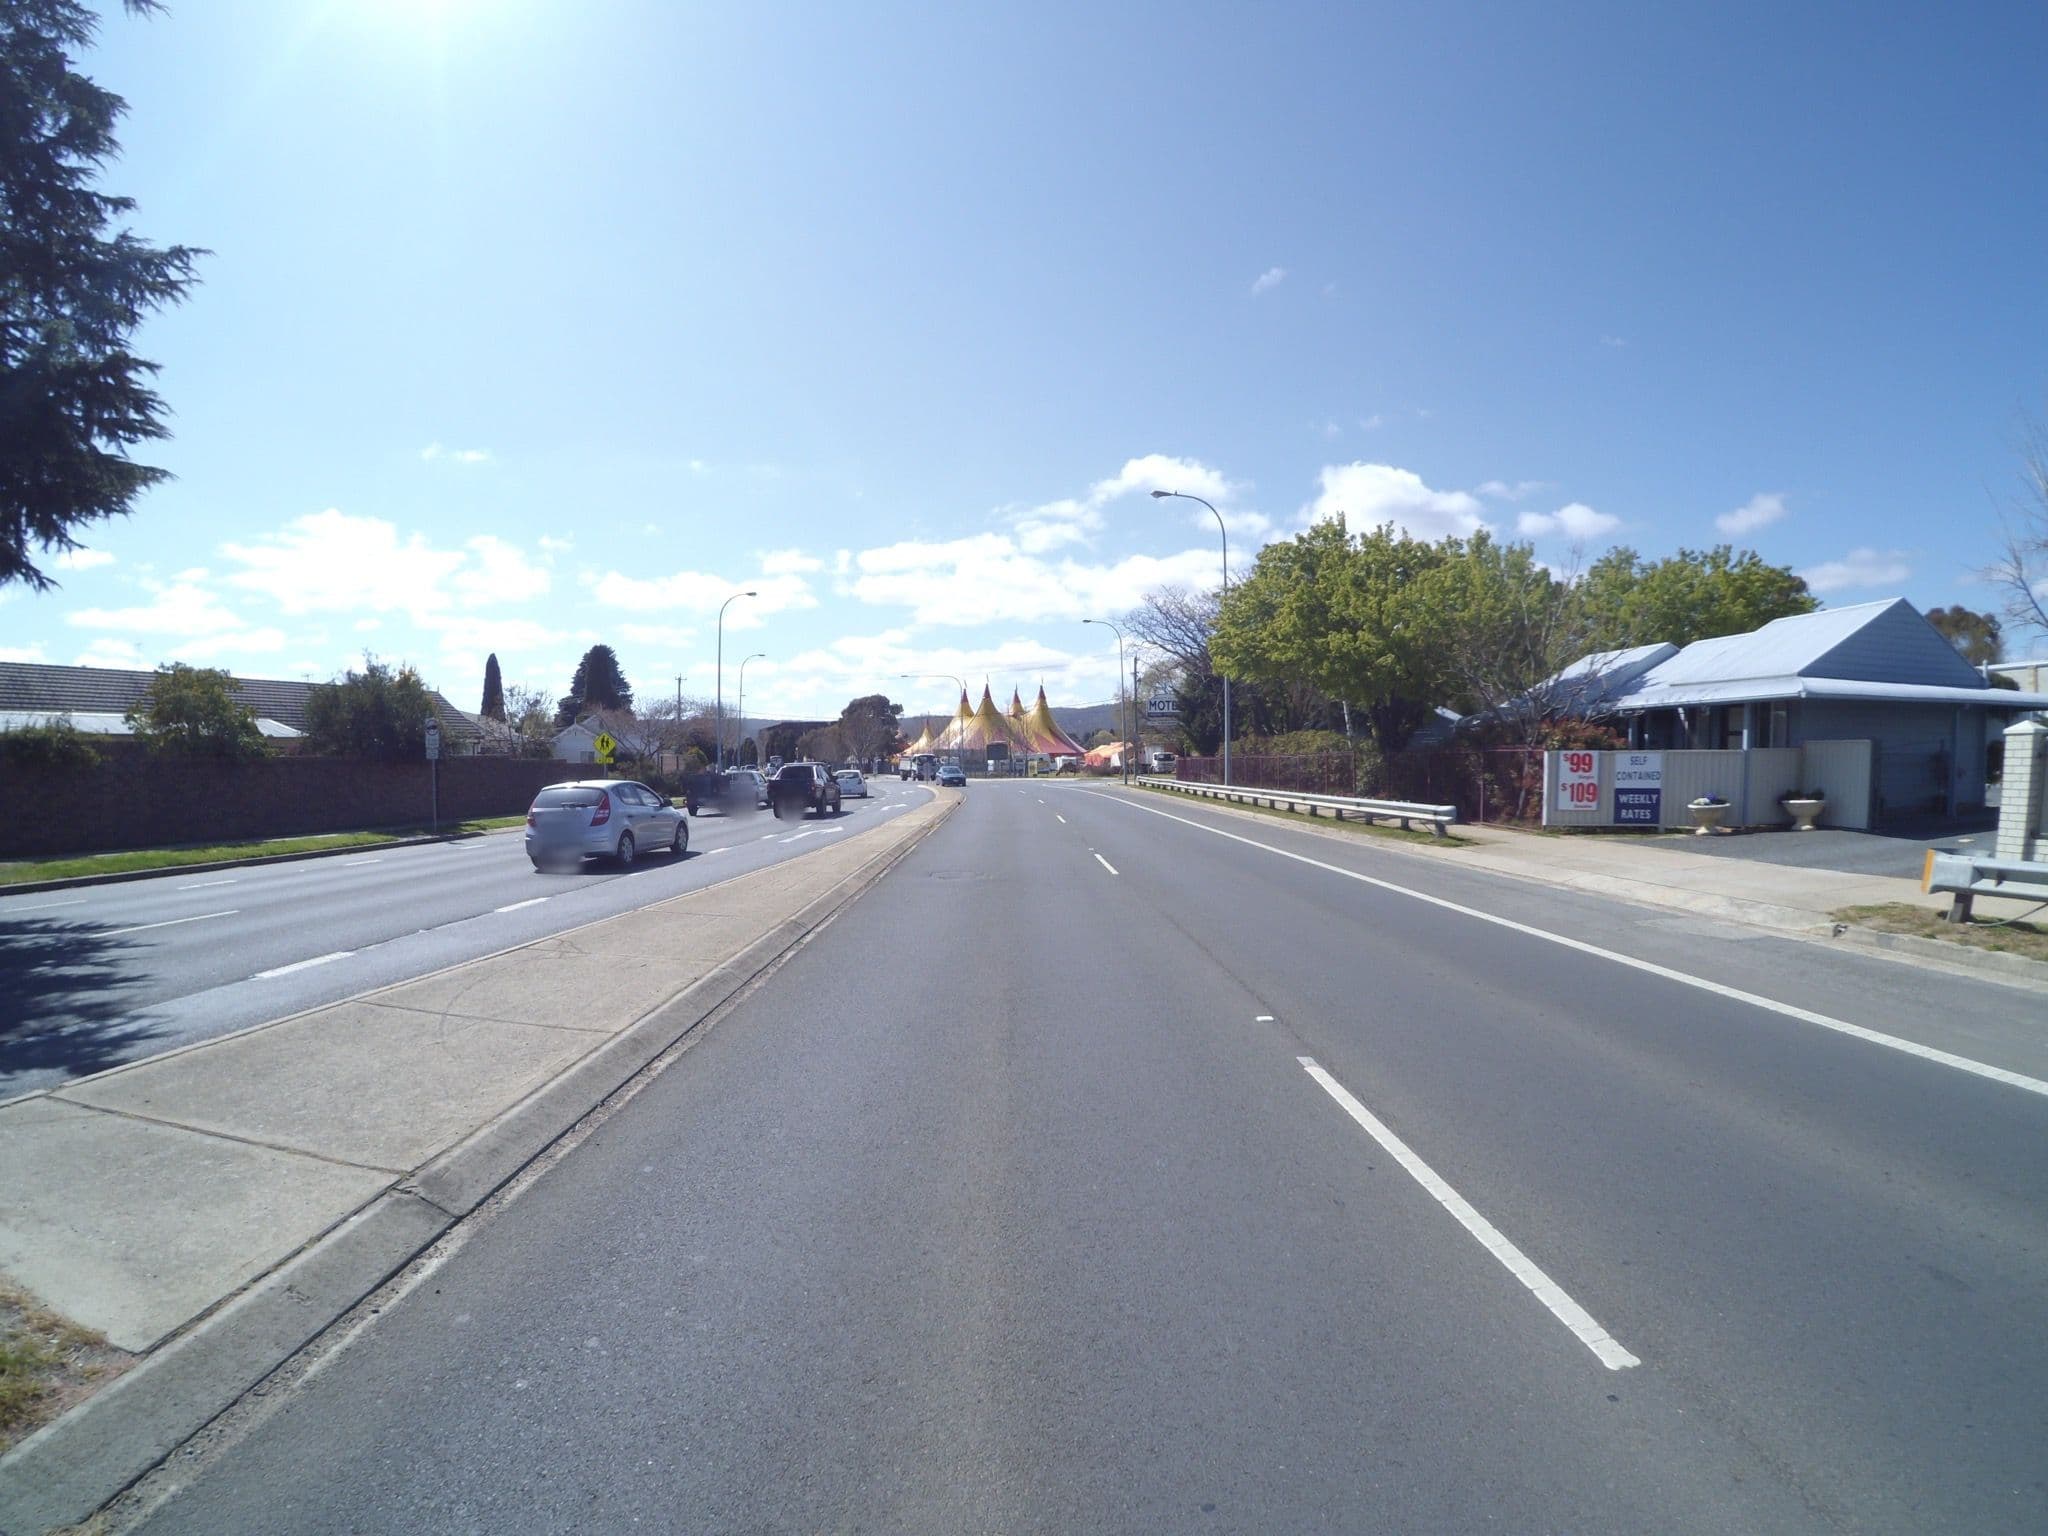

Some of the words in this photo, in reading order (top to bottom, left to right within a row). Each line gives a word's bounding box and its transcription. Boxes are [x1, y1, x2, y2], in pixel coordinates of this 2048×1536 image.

[1149, 700, 1178, 711] MOTE
[1563, 753, 1593, 773] $99
[1630, 756, 1648, 766] SELF
[1616, 771, 1661, 781] CONTAINED
[1560, 782, 1598, 803] $109
[1618, 794, 1658, 804] WEEKLY
[1620, 809, 1652, 819] RATES
